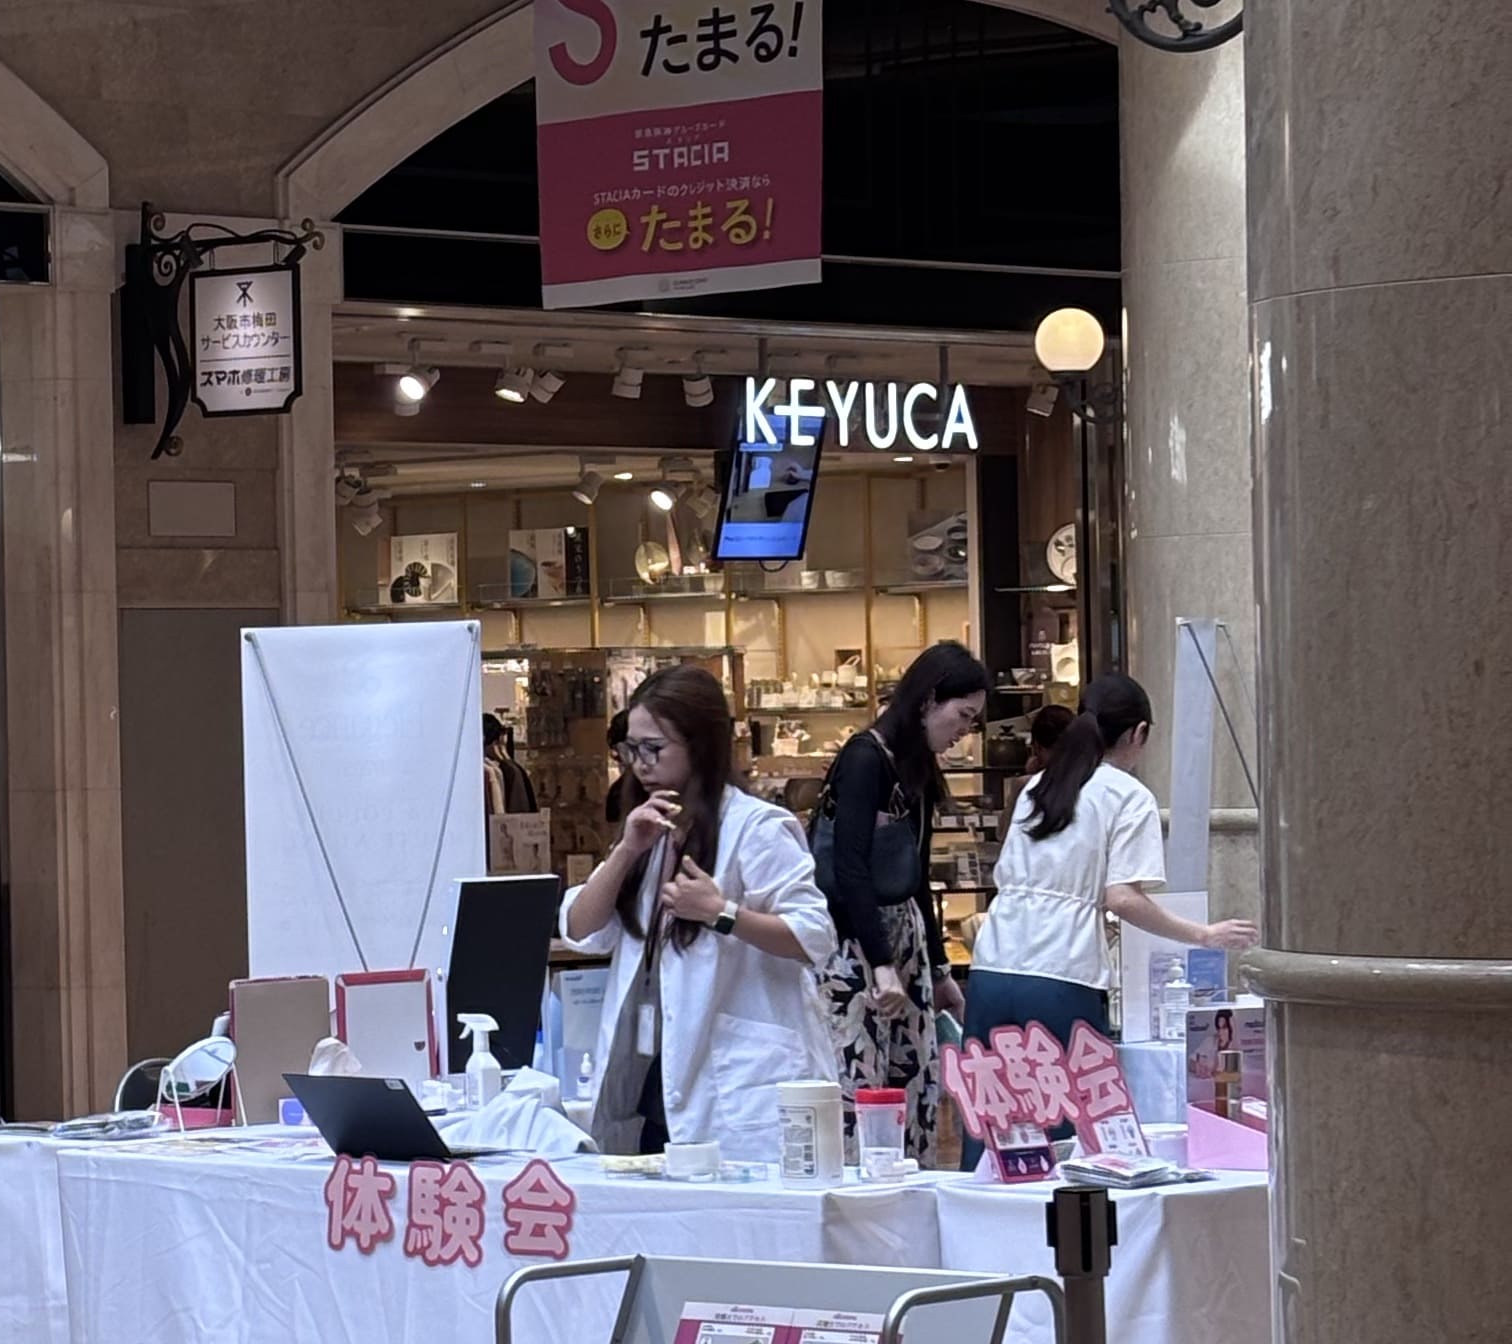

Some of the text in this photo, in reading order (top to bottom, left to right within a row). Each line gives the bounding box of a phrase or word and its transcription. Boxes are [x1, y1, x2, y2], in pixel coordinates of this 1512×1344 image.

[631, 141, 730, 172] STACIA
[593, 222, 622, 240] さらに
[213, 311, 277, 331] 大阪市梅田
[200, 330, 291, 352] サービスカウンター
[744, 375, 979, 451] KEYUCA
[940, 1018, 1133, 1140] 体験会
[324, 1152, 576, 1268] 体験会
